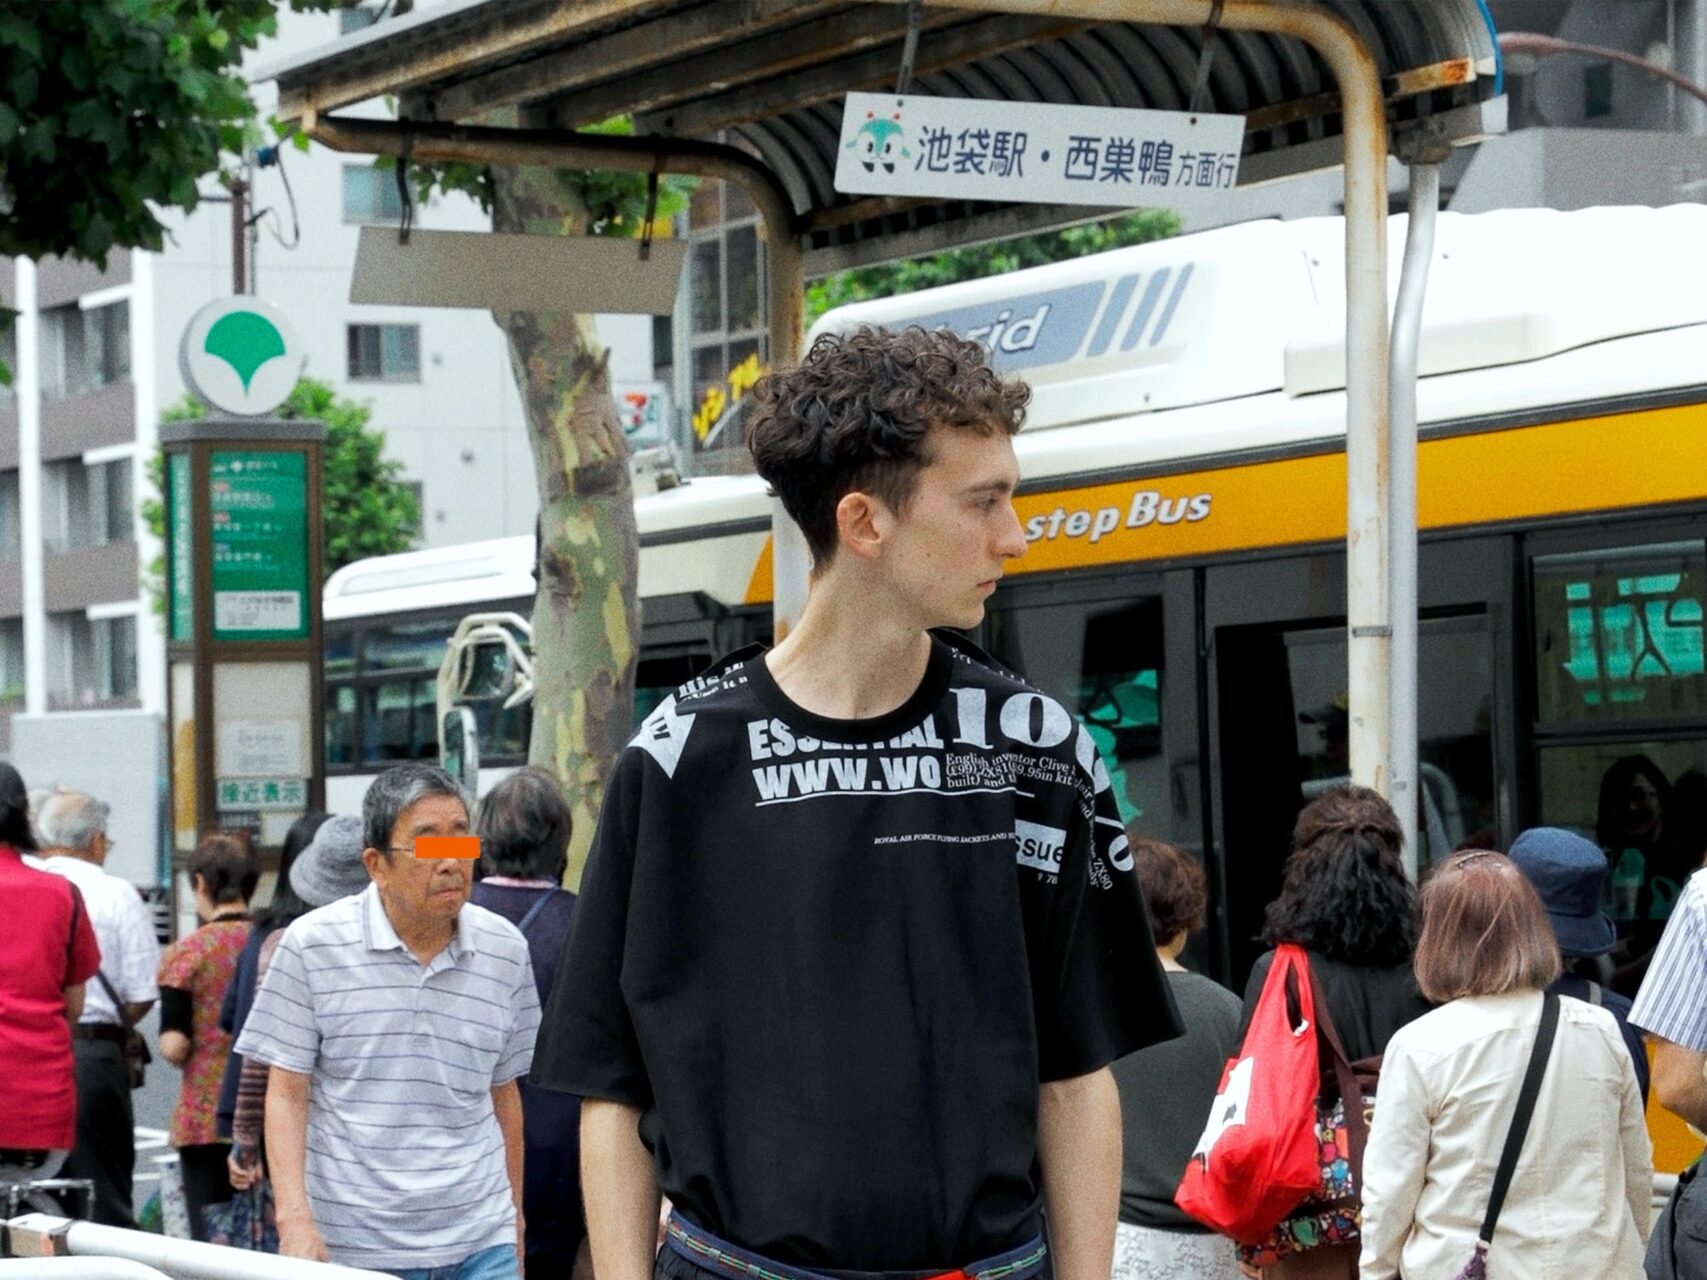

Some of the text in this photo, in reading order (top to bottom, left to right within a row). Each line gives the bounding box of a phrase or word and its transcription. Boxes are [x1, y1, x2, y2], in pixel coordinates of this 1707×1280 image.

[1025, 490, 1212, 543] step Bus
[1039, 756, 1070, 772] Clive
[752, 755, 941, 800] WWW.WO
[984, 775, 1006, 788] and
[1055, 773, 1073, 786] kit
[900, 834, 912, 843] AIR
[913, 832, 936, 842] FORCE
[989, 832, 1007, 842] AND
